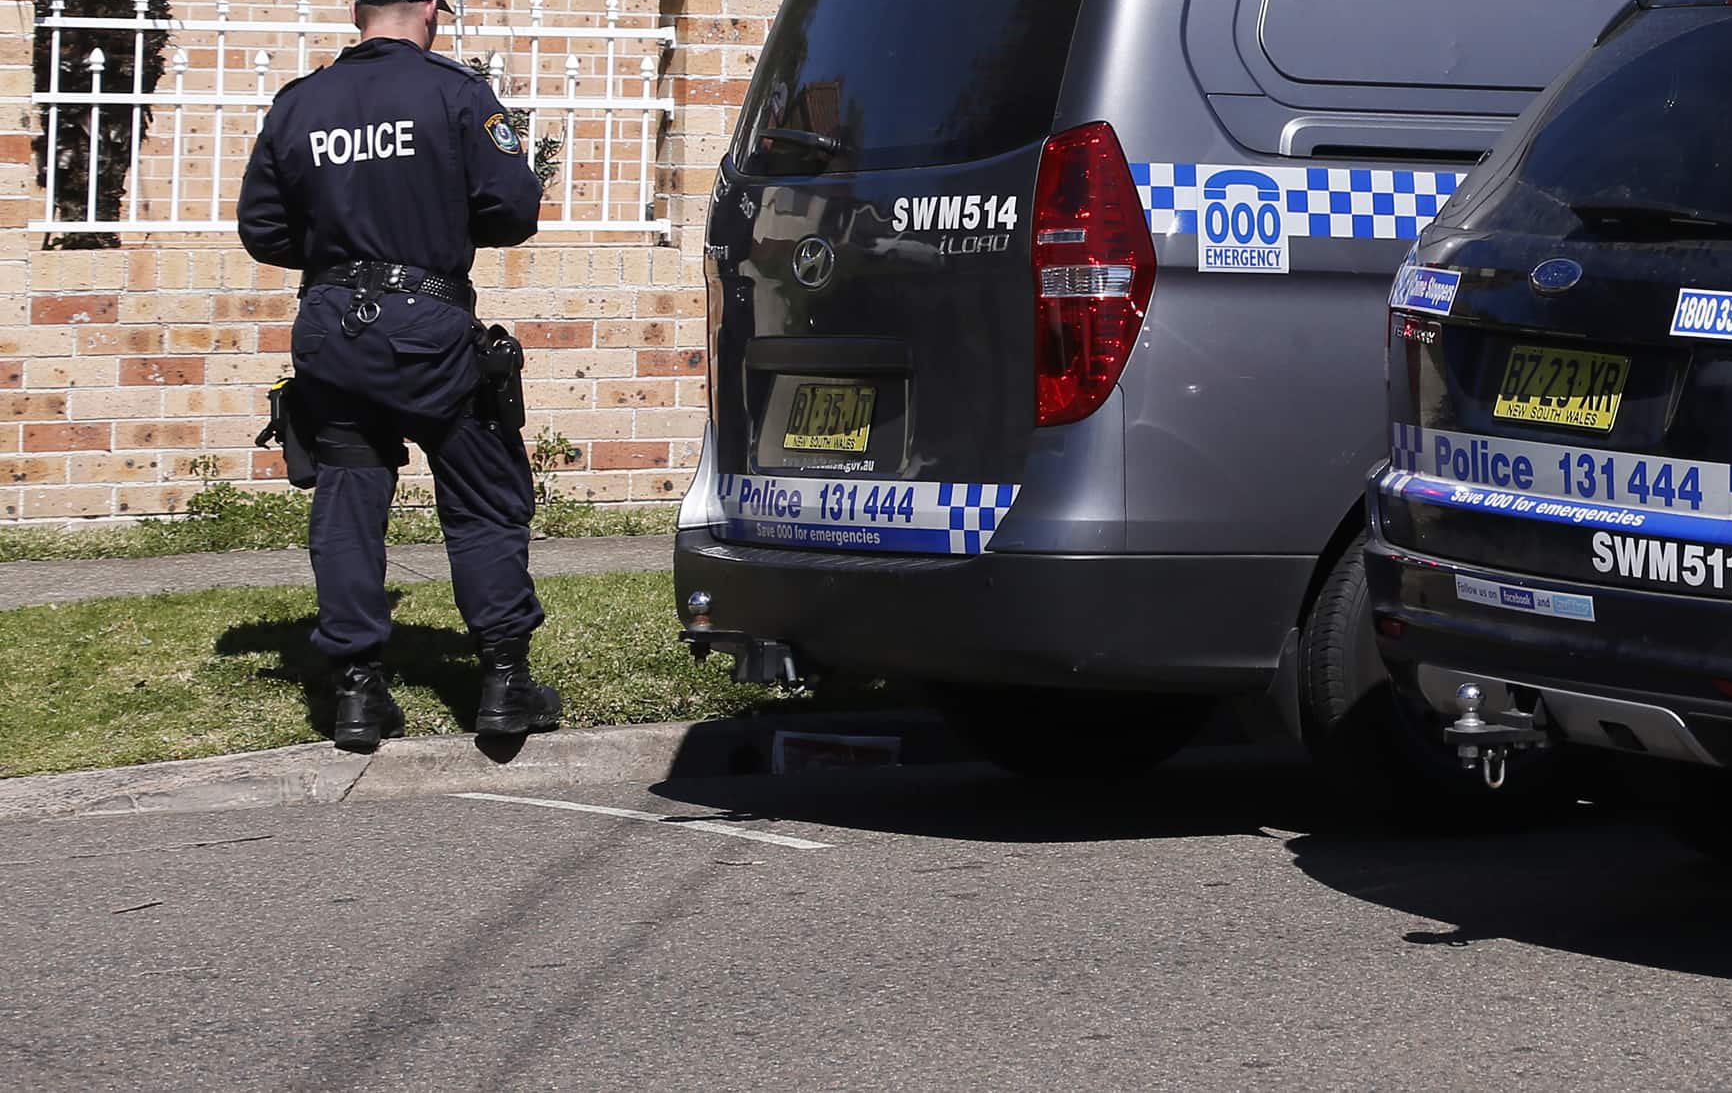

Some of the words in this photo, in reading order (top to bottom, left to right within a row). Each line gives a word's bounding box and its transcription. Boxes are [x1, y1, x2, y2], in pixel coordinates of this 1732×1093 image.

[309, 120, 415, 167] POLICE
[892, 194, 1018, 231] SWM514
[1205, 201, 1281, 245] 000
[1206, 248, 1281, 267] EMERGENCY
[1425, 276, 1455, 306] Stoppers
[1678, 296, 1718, 330] 1800
[1507, 403, 1527, 418] NEW
[1530, 406, 1561, 421] SOUTH
[1566, 409, 1598, 426] WALES
[1435, 435, 1535, 490] Police
[1558, 451, 1615, 501] 131
[1627, 460, 1703, 511] 444
[739, 478, 801, 518] Police
[819, 483, 857, 521] 131
[863, 485, 914, 523] 444
[1451, 489, 1484, 505] Save
[1484, 493, 1513, 509] 000
[1512, 496, 1537, 513] for
[1536, 502, 1646, 527] emergencies
[756, 522, 776, 538] Save
[776, 524, 793, 539] 000
[795, 524, 808, 540] for
[810, 528, 881, 546] emergencies
[1457, 581, 1478, 595] Follow
[1479, 589, 1488, 598] us
[1487, 591, 1498, 600] on
[1503, 590, 1532, 606] facebook
[1537, 597, 1550, 609] and
